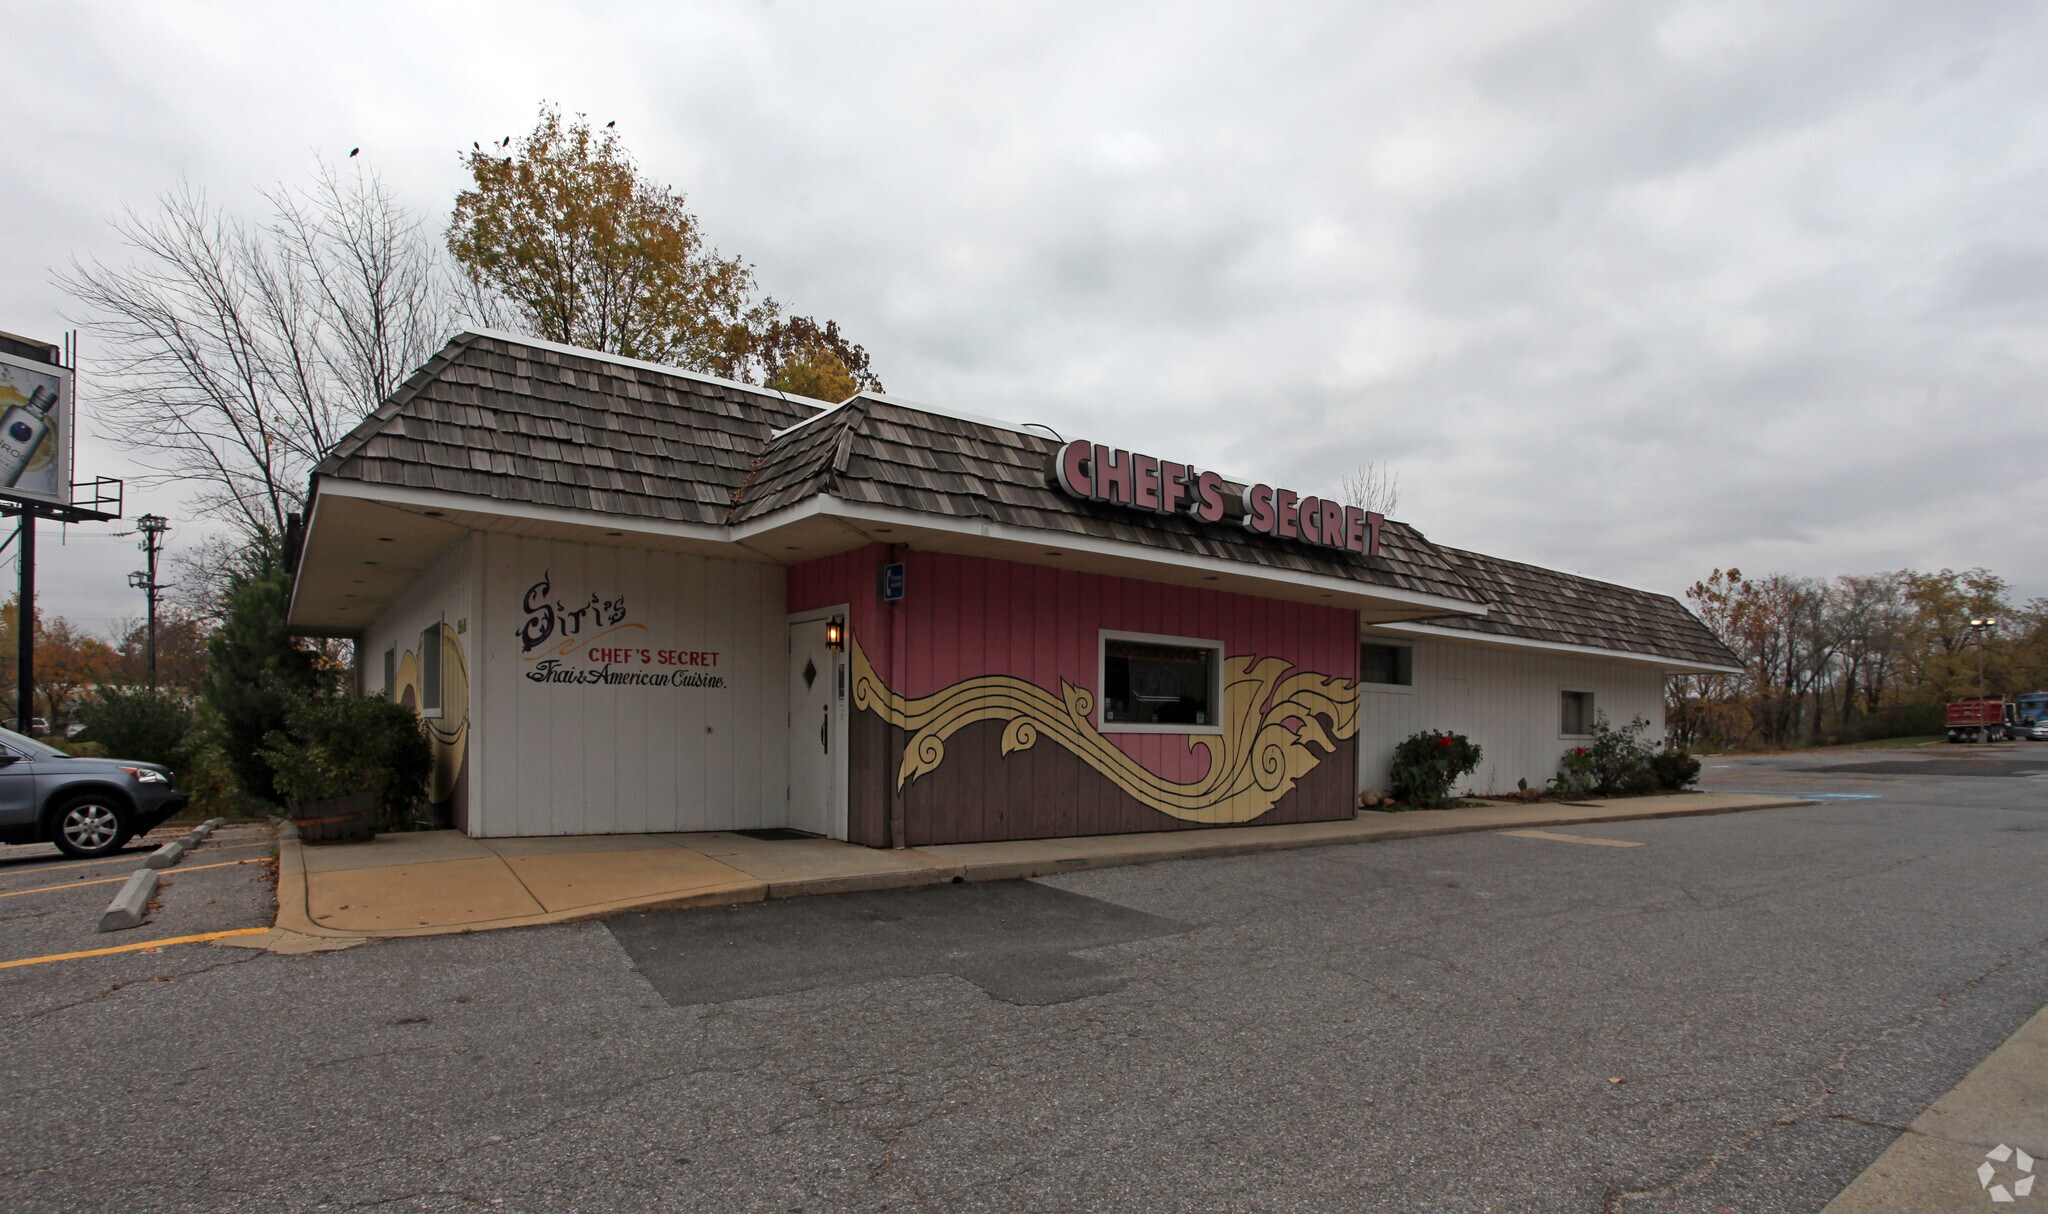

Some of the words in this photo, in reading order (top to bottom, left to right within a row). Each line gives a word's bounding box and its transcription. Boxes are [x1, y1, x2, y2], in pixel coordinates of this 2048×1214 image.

[1056, 439, 1224, 522] CHEF'S
[1243, 484, 1384, 556] SECRET
[588, 648, 651, 664] CHEF'S
[657, 650, 719, 667] SECRET
